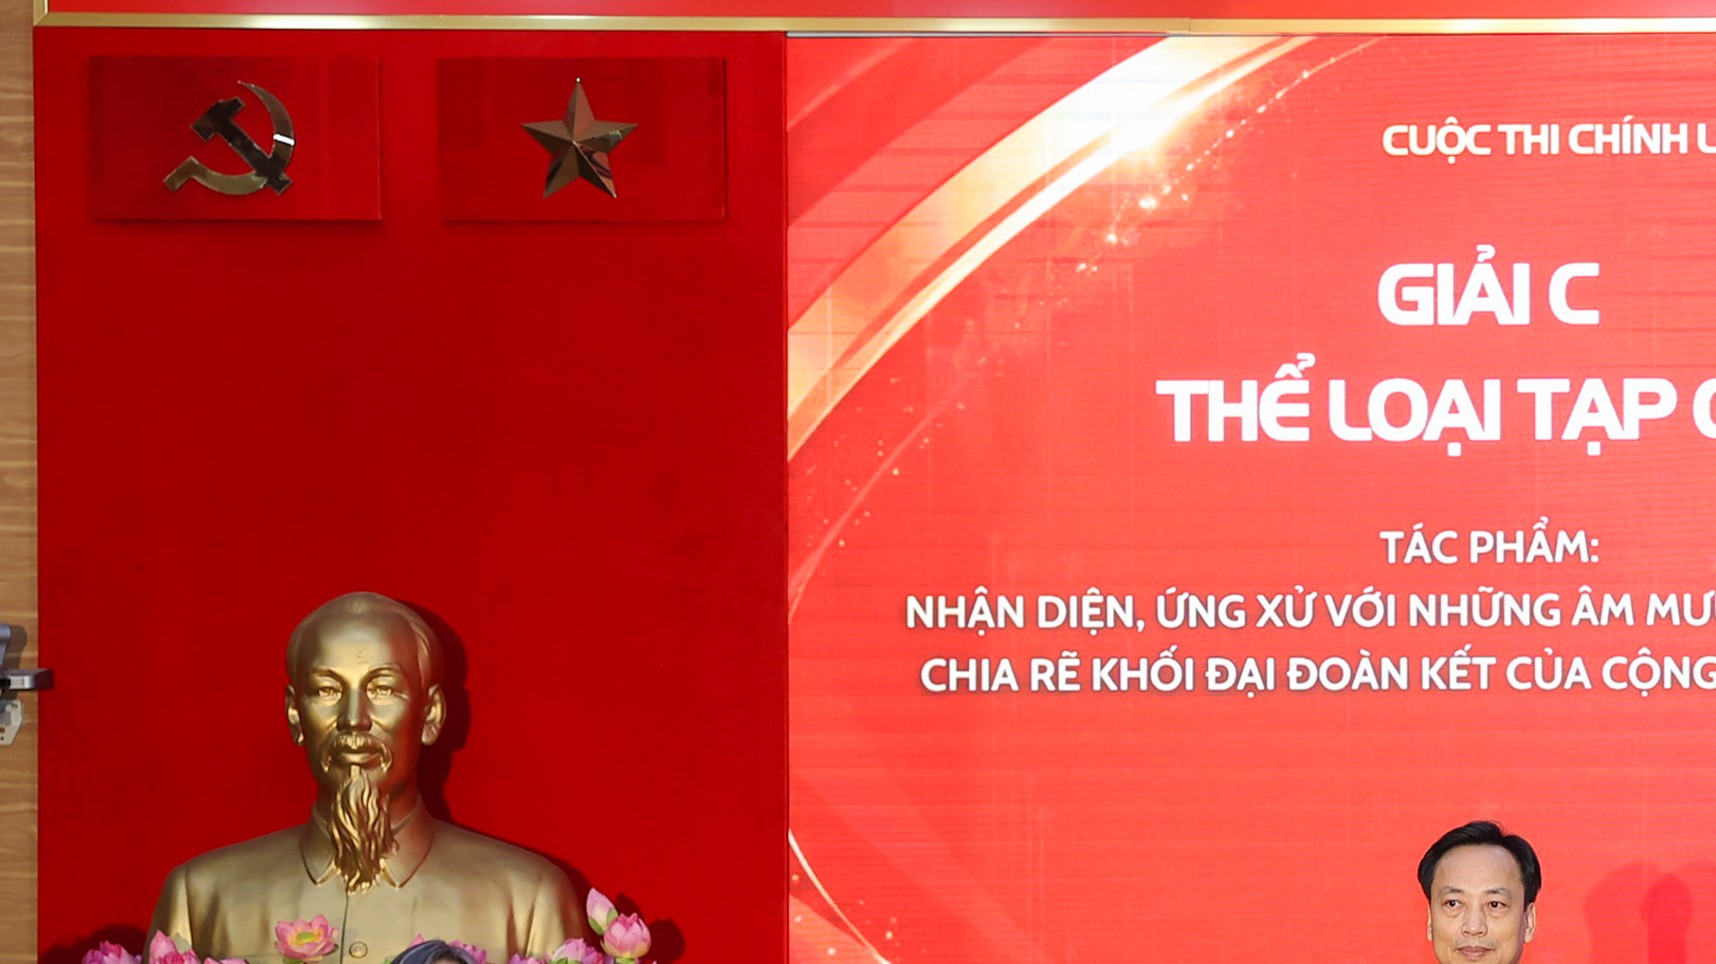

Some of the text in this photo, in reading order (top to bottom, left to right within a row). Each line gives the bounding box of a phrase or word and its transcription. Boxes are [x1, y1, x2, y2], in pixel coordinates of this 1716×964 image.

[1382, 116, 1492, 164] CUỘC
[1497, 123, 1560, 155] THI
[1568, 114, 1689, 155] CHÍNH
[1377, 244, 1600, 326] GIẢI C
[1155, 352, 1316, 442] THỂ
[1328, 377, 1501, 457] LOẠI
[1516, 377, 1678, 456] TẠP
[1379, 515, 1599, 564] TÁC PHẨM:
[907, 586, 1024, 636] NHẬN
[1038, 586, 1146, 636] DIỆN,
[1157, 586, 1246, 629] ỨNG
[1256, 585, 1318, 628] XỬ
[1324, 585, 1396, 628] VỚI
[1409, 585, 1561, 627] NHỮNG
[1571, 584, 1635, 626] ÂM
[921, 658, 1019, 692] CHIA
[1030, 650, 1081, 691] RẼ
[1092, 644, 1194, 691] KHỐI
[1205, 657, 1275, 698] ĐẠI
[1286, 649, 1408, 691] ĐOÀN
[1421, 643, 1497, 690] KẾT
[1506, 647, 1592, 690] CỦA
